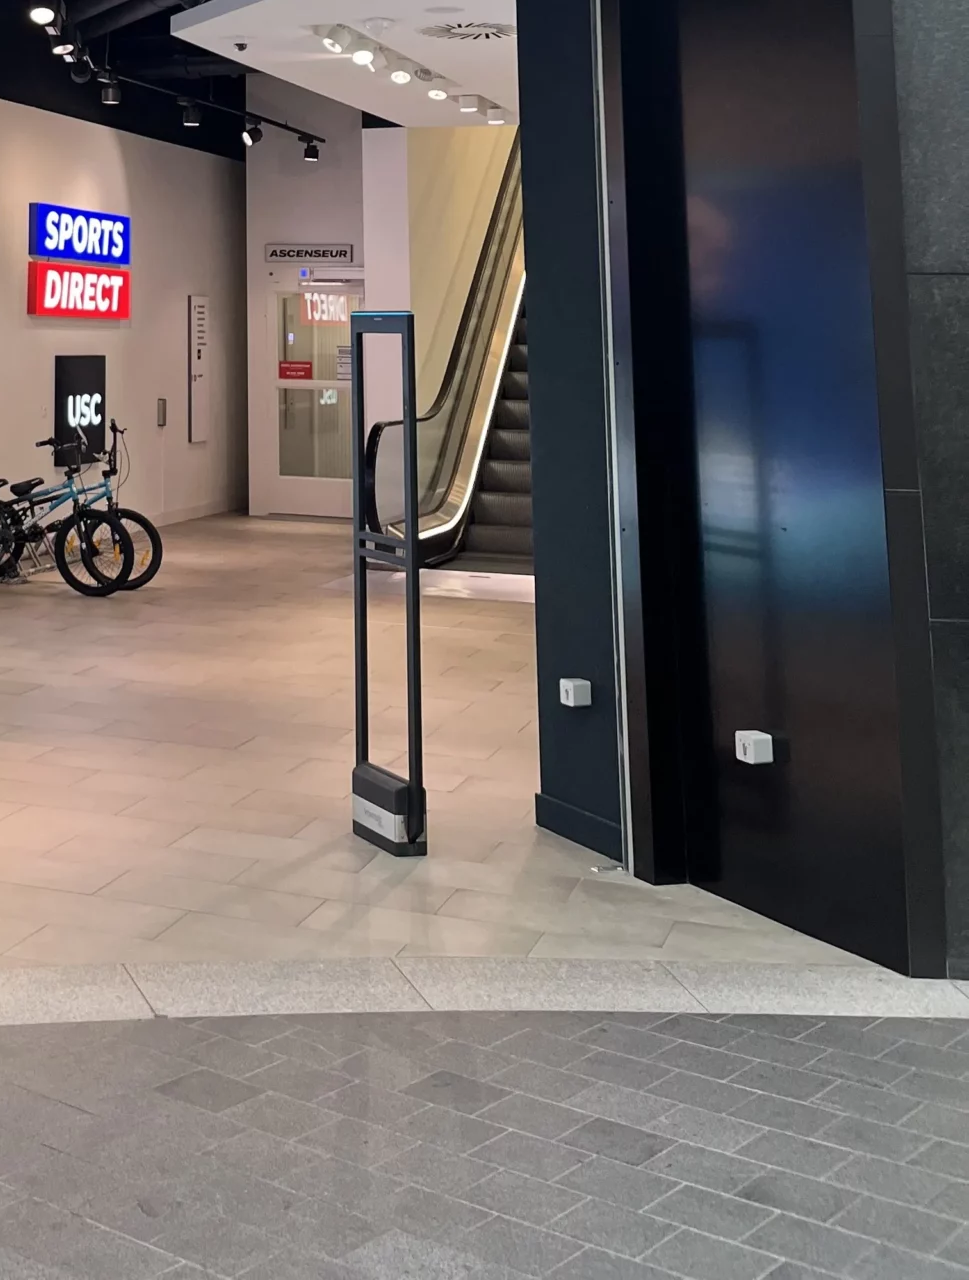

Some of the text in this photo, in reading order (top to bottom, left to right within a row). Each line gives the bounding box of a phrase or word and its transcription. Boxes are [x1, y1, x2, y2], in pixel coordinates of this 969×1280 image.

[44, 210, 124, 258] SPORTS
[269, 249, 348, 259] ASCENSEUR
[44, 269, 124, 312] DIRECT
[67, 393, 102, 428] USC
